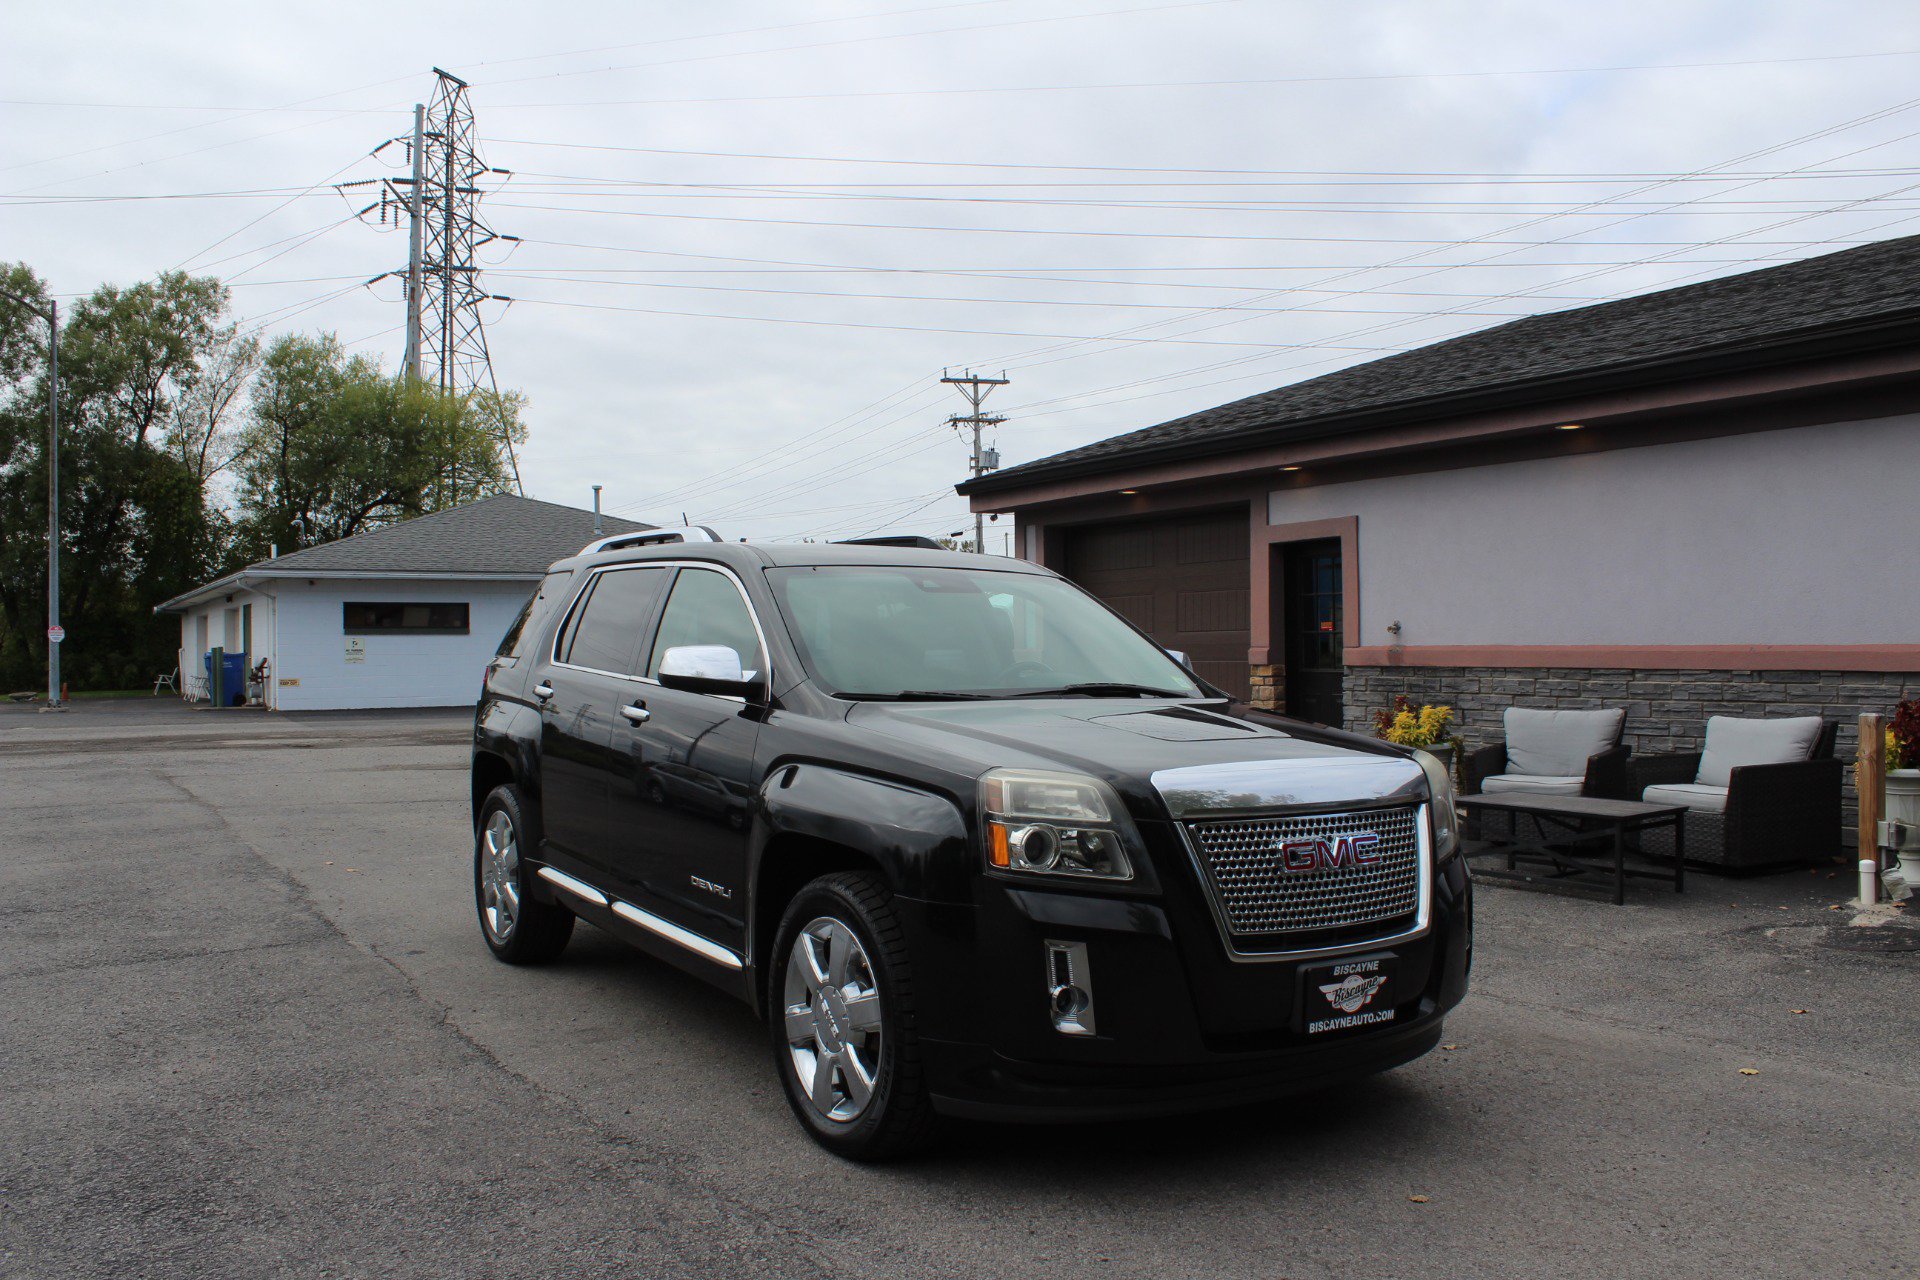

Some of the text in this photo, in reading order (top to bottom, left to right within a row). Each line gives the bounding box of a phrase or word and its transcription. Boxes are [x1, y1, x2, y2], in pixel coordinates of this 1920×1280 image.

[1280, 834, 1381, 872] GMC
[1333, 960, 1380, 976] BISCAYNE
[1333, 976, 1379, 1005] Biscayne
[1308, 1009, 1395, 1034] BISCAYNEAUTO.COM
